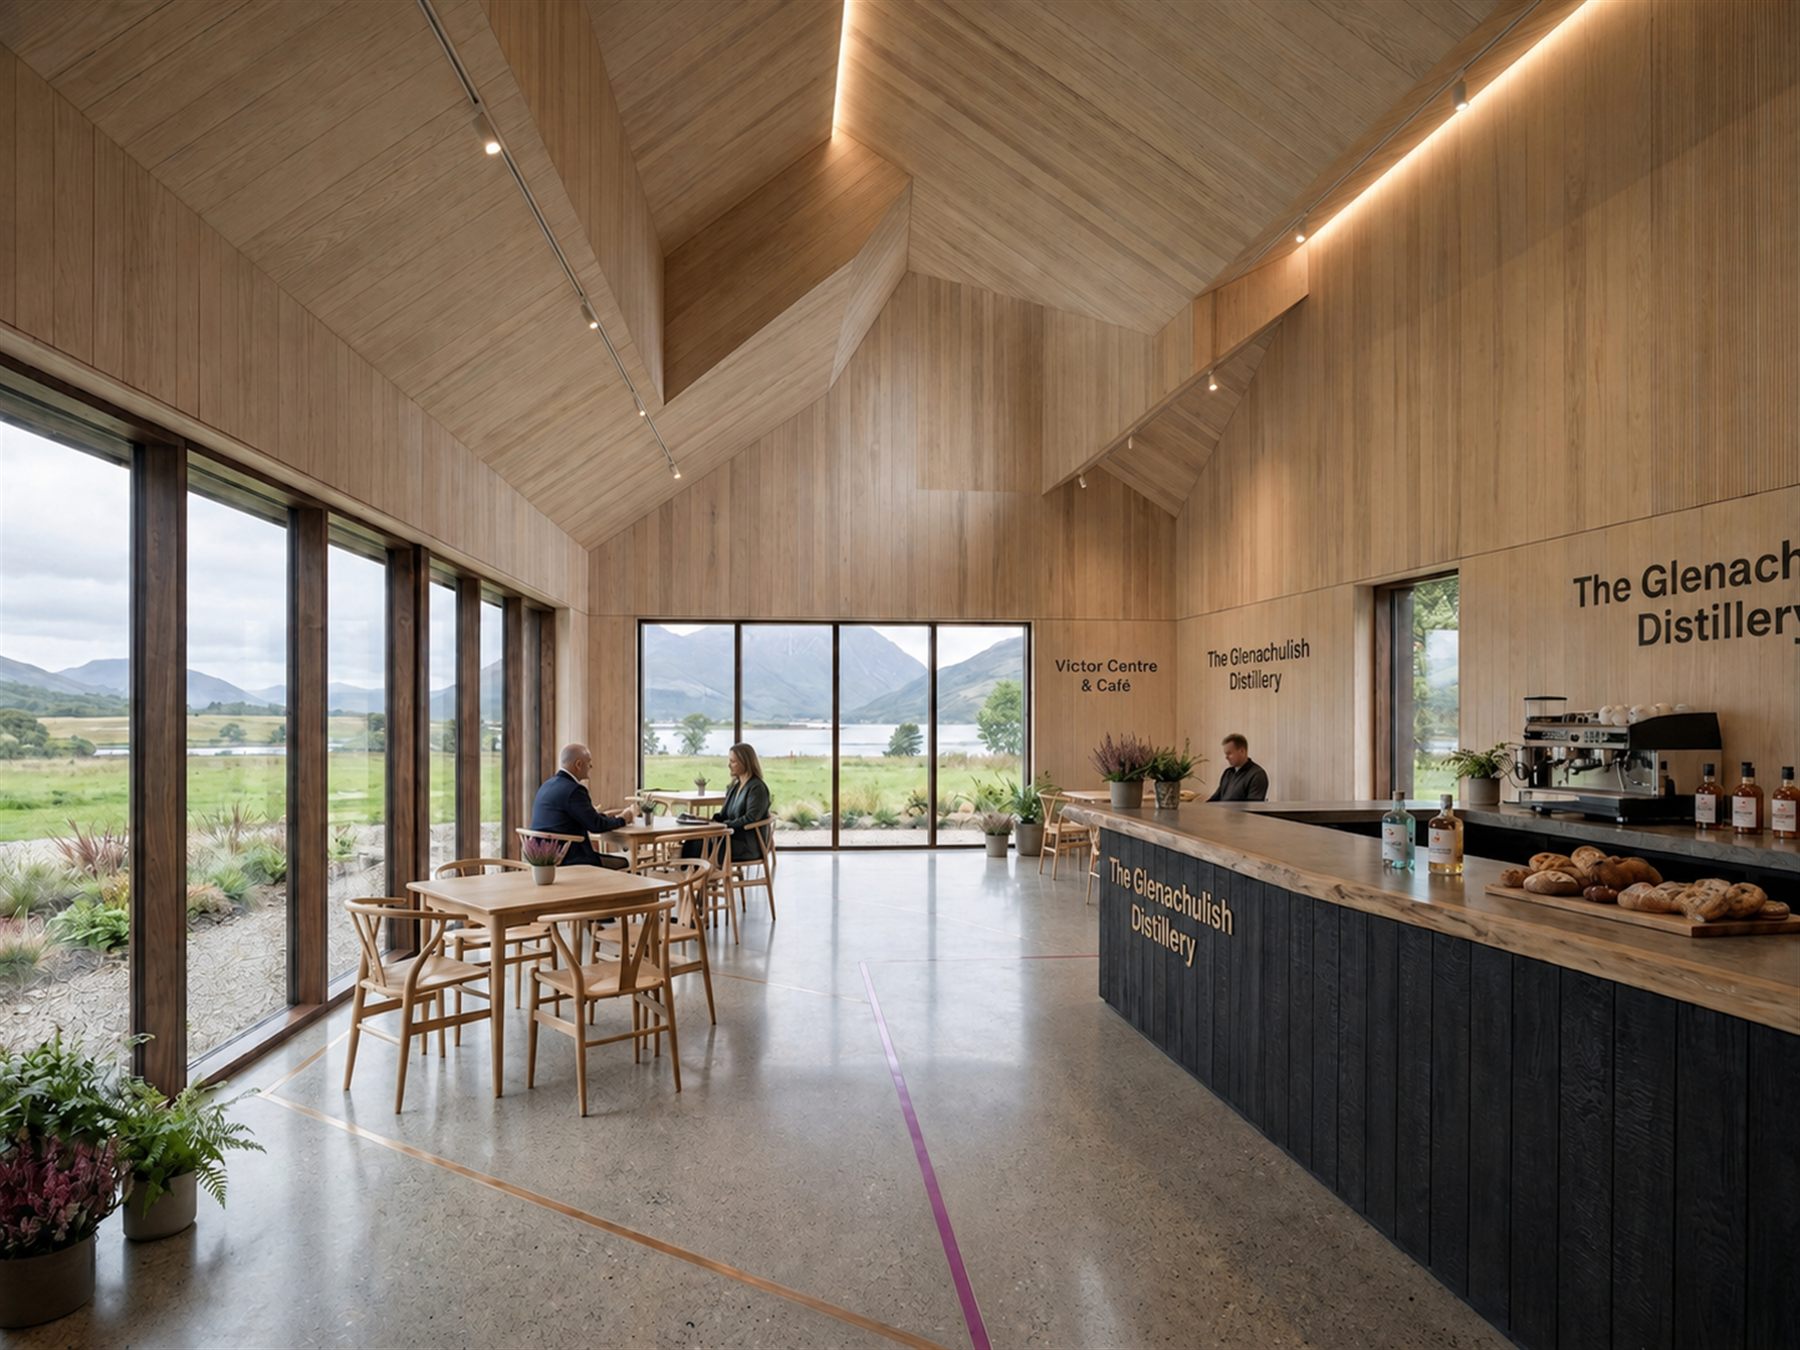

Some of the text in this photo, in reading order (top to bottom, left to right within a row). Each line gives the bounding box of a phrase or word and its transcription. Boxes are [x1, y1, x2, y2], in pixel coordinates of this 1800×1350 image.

[1573, 539, 1800, 608] The Glenach
[1055, 659, 1158, 673] Victor Centre
[1208, 638, 1310, 668] The Glenachulish
[1081, 678, 1131, 692] & Café
[1230, 670, 1282, 693] Distillery
[1109, 856, 1234, 936] The Glenachulish
[1131, 903, 1197, 968] Distillery
